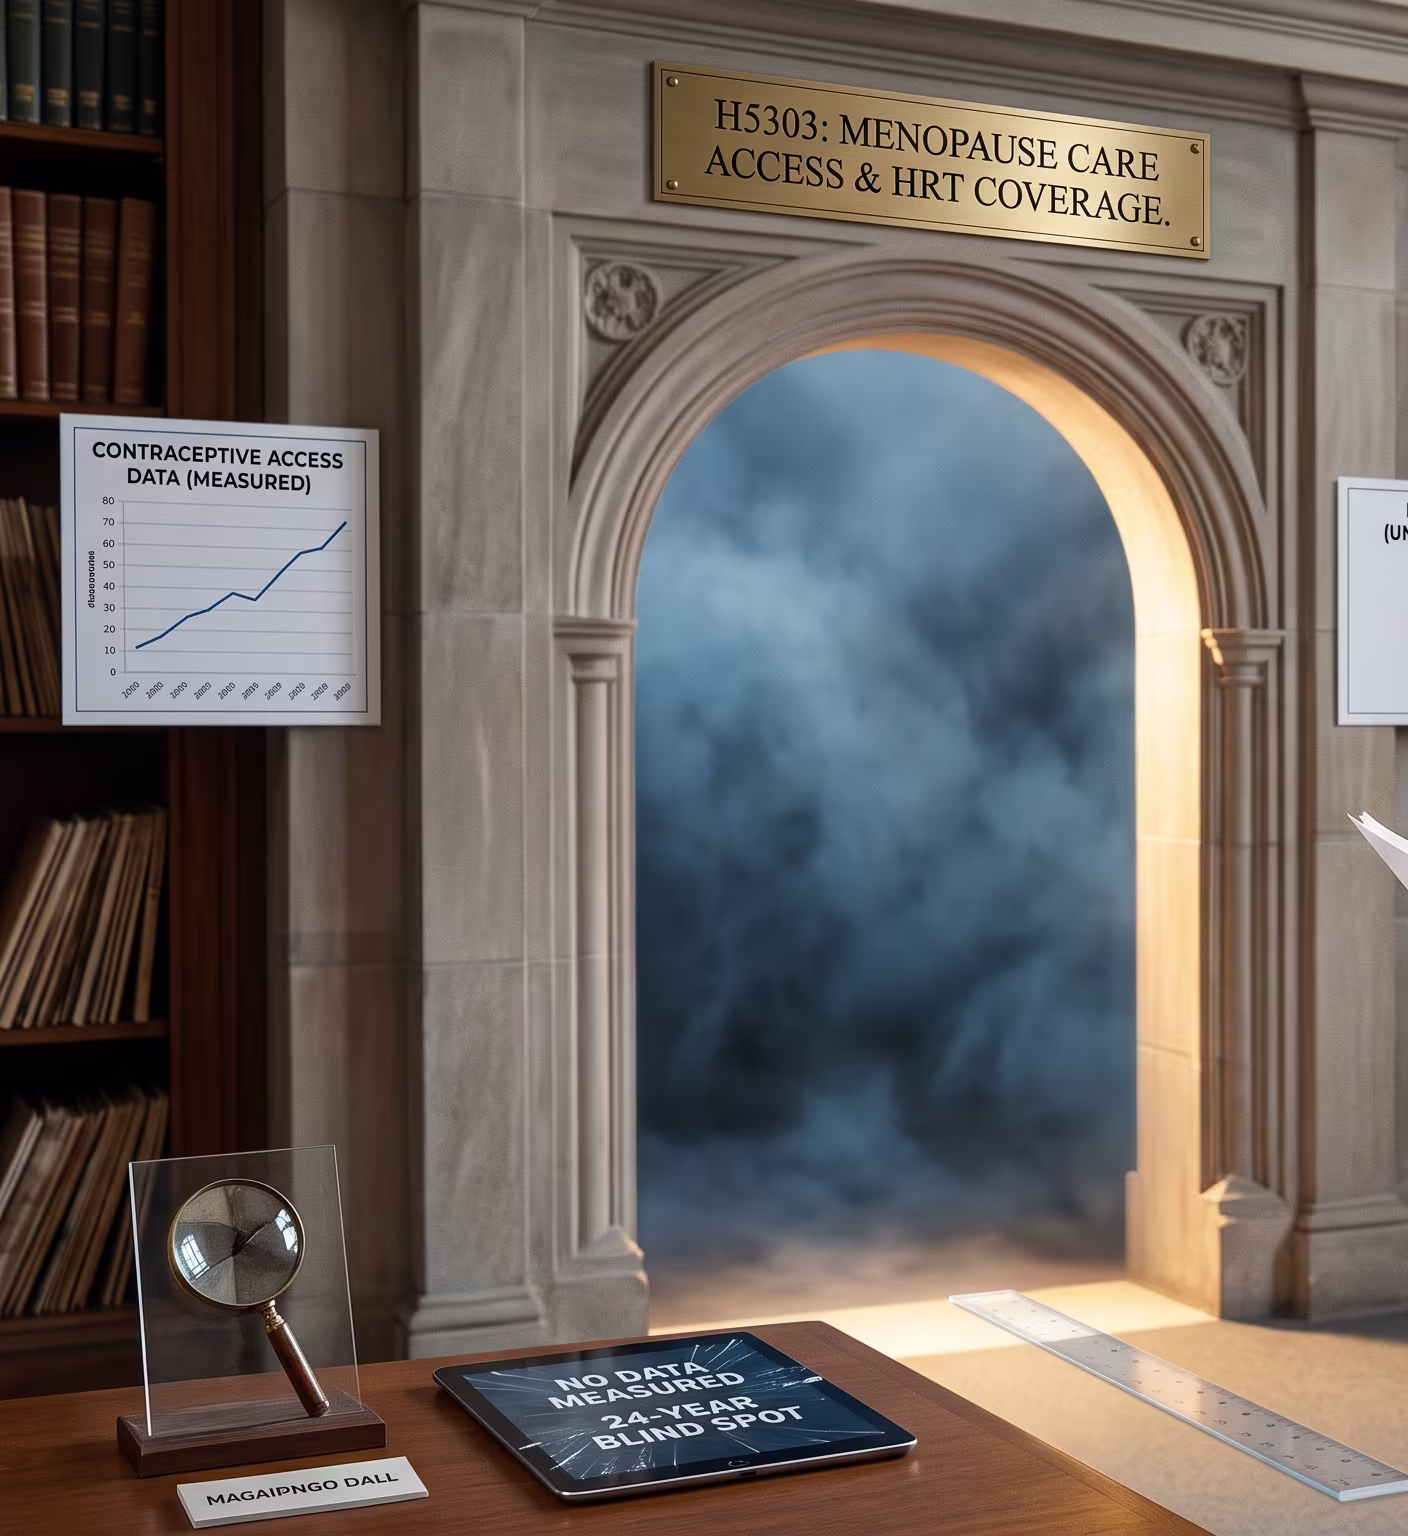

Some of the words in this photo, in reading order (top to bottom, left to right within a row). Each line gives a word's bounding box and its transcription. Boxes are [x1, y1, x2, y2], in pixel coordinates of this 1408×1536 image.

[714, 98, 829, 143] H5303:
[839, 114, 1059, 169] MENOPAUSE
[1067, 143, 1160, 182] CARE
[704, 145, 845, 190] ACCESS
[854, 163, 882, 194] &
[891, 167, 965, 202] HRT
[974, 176, 1172, 227] COVERAGE.
[92, 441, 261, 466] CONTRACEPTIVE
[267, 450, 344, 470] ACCESS
[127, 467, 181, 487] DATA
[187, 469, 311, 496] (MEASURED)
[102, 496, 115, 506] 80
[103, 518, 115, 527] 70
[102, 539, 115, 549] 60
[103, 560, 115, 570] 50
[103, 582, 115, 591] 40
[103, 603, 116, 613] 30
[103, 625, 116, 634] 20
[104, 646, 116, 655] 10
[110, 668, 116, 677] 0
[554, 1372, 609, 1393] NO
[614, 1361, 710, 1385] DATA
[547, 1372, 746, 1411] MEASURED
[600, 1395, 759, 1431] 24-YEAR
[592, 1422, 706, 1451] BLIND
[715, 1405, 805, 1433] SPOT
[344, 1472, 399, 1488] DALL
